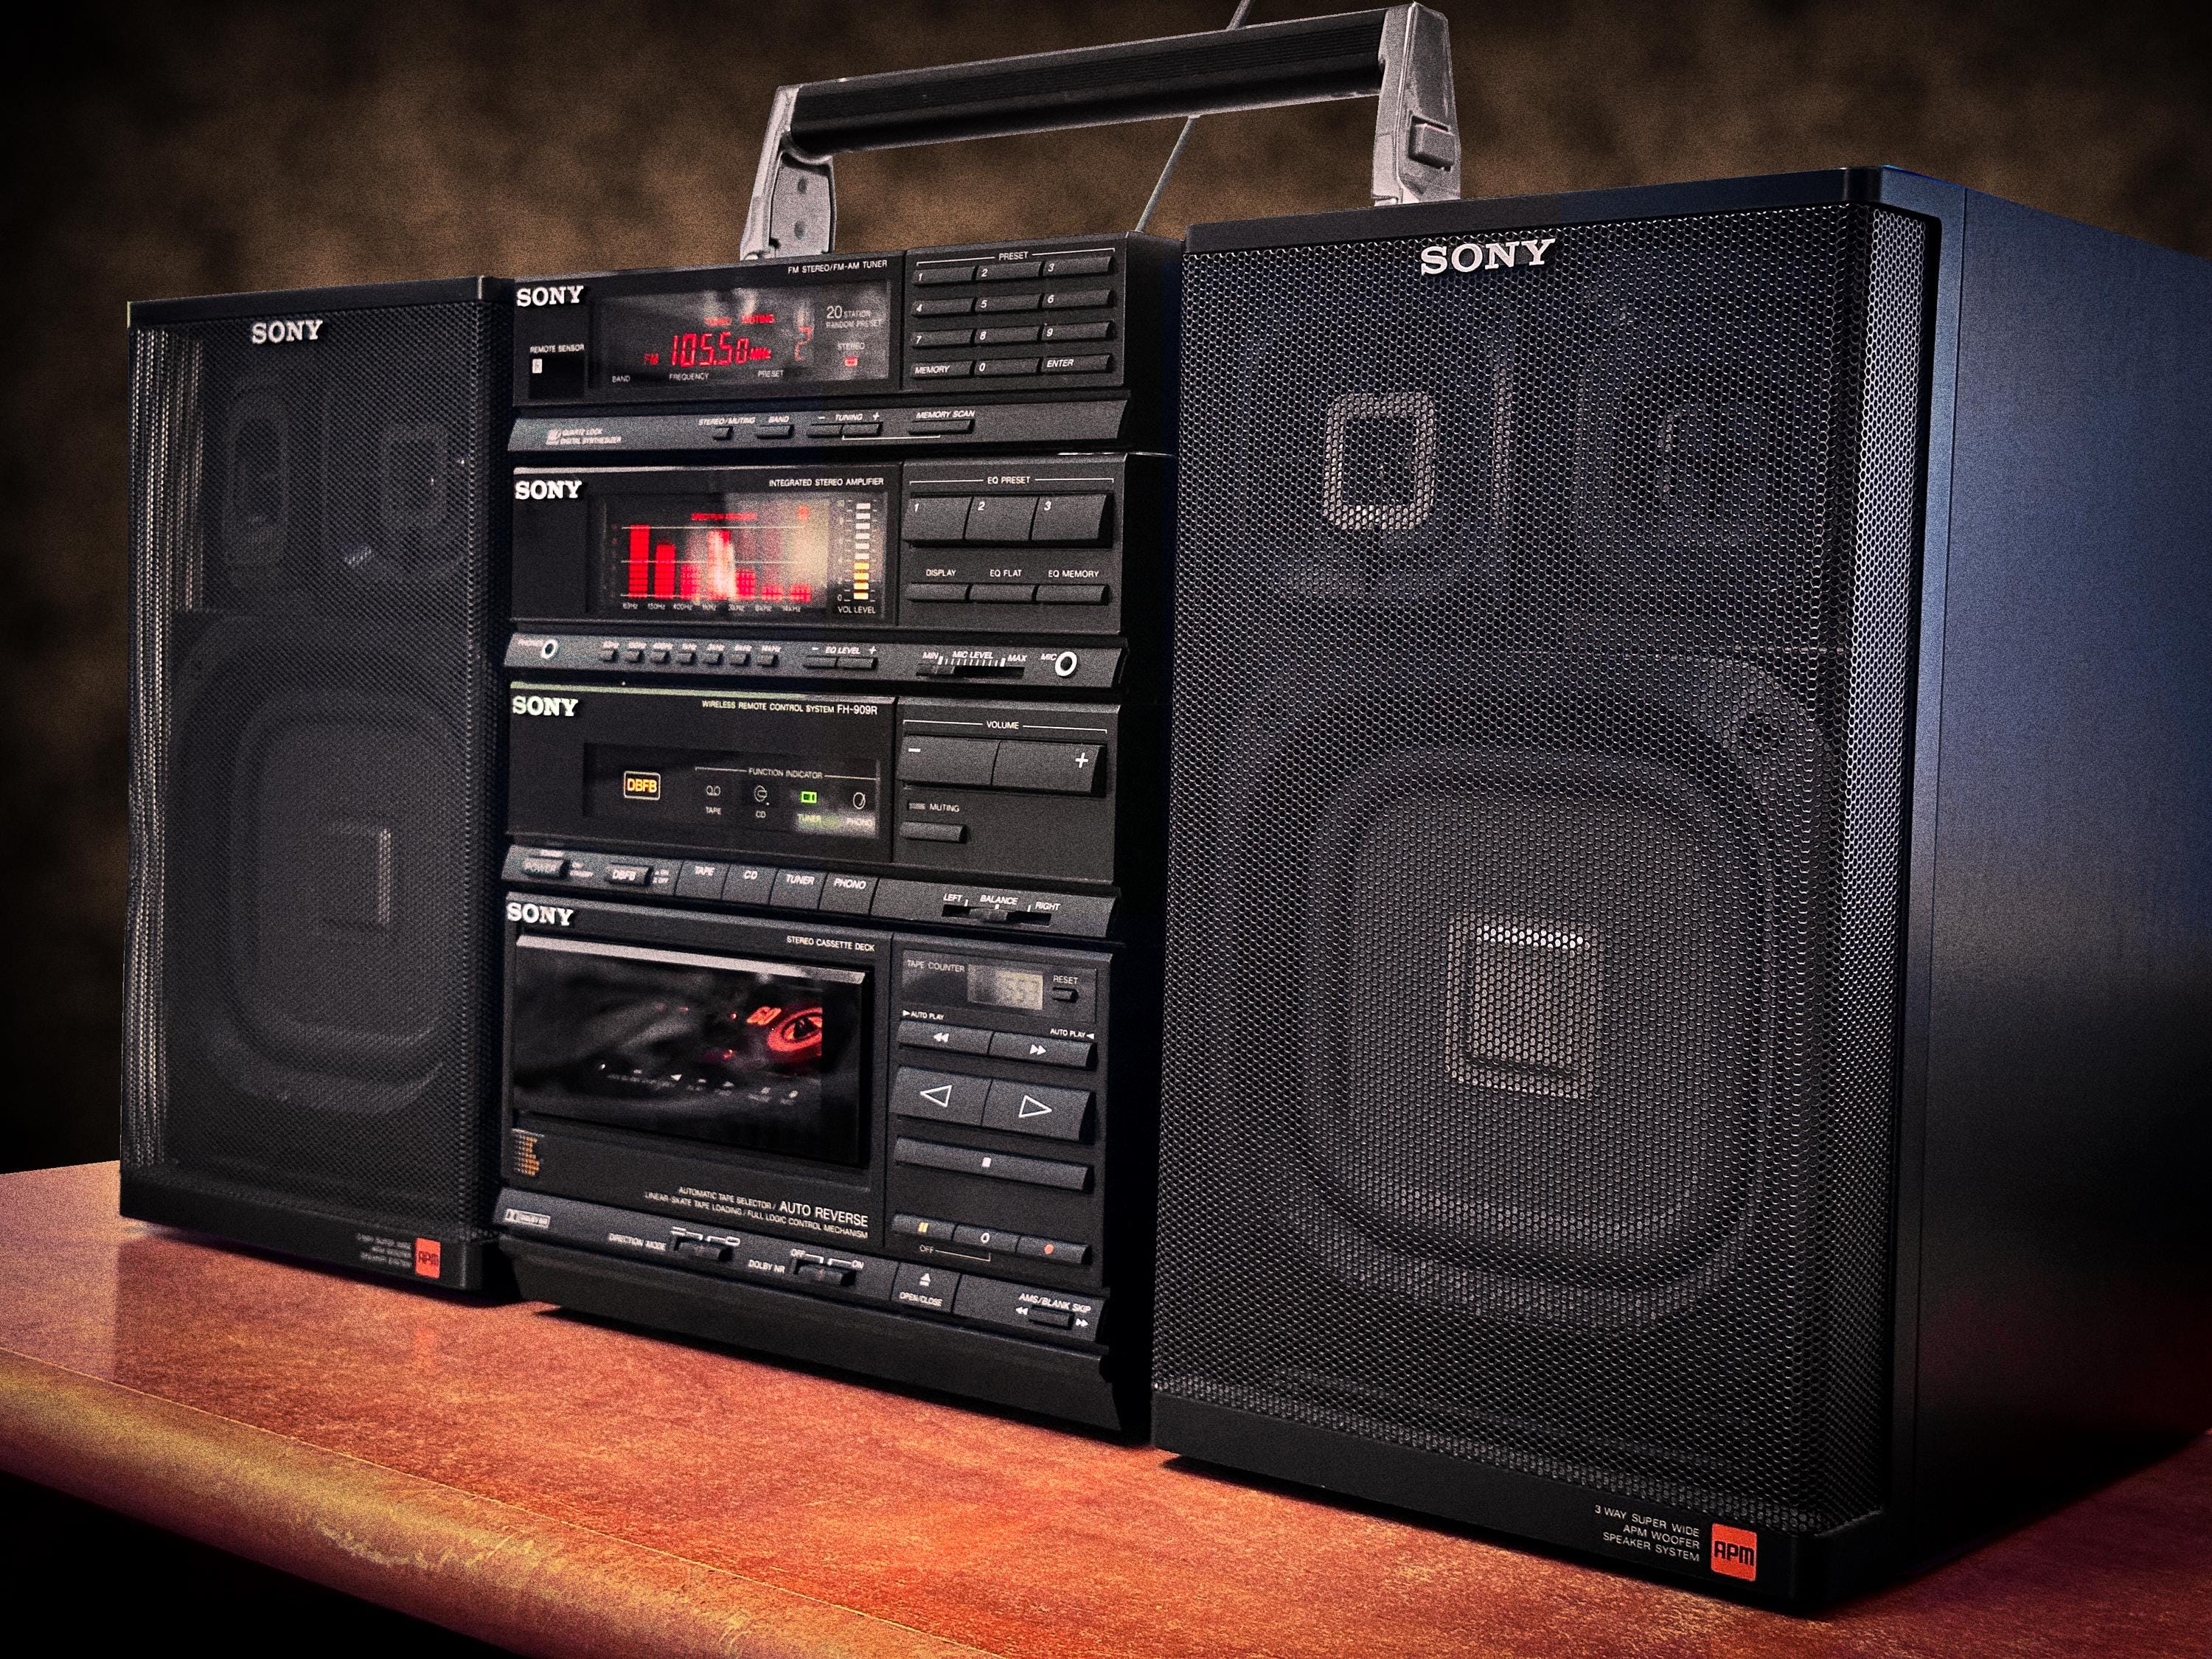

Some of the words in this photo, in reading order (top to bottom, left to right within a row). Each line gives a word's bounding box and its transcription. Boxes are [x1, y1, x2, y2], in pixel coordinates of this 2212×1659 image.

[999, 251, 1029, 260] PRESET
[1421, 238, 1556, 276] SONY
[787, 266, 799, 274] FM
[801, 262, 860, 274] STEREO/FM-AM
[863, 260, 888, 268] TUNER
[1048, 264, 1054, 272] 3
[918, 273, 923, 282] 1
[981, 268, 988, 277] 2
[517, 285, 584, 307] SONY
[1047, 295, 1054, 303] 6
[916, 304, 922, 312] 4
[981, 300, 987, 308] 5
[827, 305, 842, 319] 20
[844, 310, 872, 319] STATION
[251, 319, 323, 344] SONY
[979, 332, 987, 340] 8
[1046, 328, 1053, 337] 9
[916, 335, 922, 344] 7
[529, 345, 556, 353] REMOTE
[558, 344, 585, 352] SENSOR
[644, 353, 660, 365] FM
[671, 331, 750, 368] 105.50
[837, 342, 866, 351] STEREO
[979, 363, 986, 372] 0
[1046, 359, 1074, 368] ENTER
[757, 369, 784, 378] PRESET
[914, 366, 950, 375] MEMORY
[669, 372, 709, 381] FREQUENCY
[835, 413, 863, 422] TUNING
[916, 411, 951, 420] MEMORY
[953, 410, 975, 418] SCAN
[769, 479, 813, 487] INTEGRATED
[815, 478, 844, 487] STEREO
[846, 478, 884, 487] AMPLIFIER
[987, 476, 998, 484] EQ
[1001, 476, 1030, 484] PRESET
[515, 479, 582, 500] SONY
[914, 503, 919, 512] 1
[978, 501, 985, 511] 2
[1043, 501, 1051, 511] 3
[926, 568, 956, 577] DISPLAY
[990, 569, 1001, 577] EQ
[1004, 569, 1022, 577] FLAT
[1048, 569, 1060, 578] EQ
[1062, 570, 1099, 578] MEMORY
[838, 606, 852, 614] VOL
[854, 606, 876, 614] LEVEL
[825, 646, 837, 654] EQ
[838, 647, 860, 655] LEVEL
[922, 651, 939, 660] MIN
[952, 650, 968, 658] MIC
[970, 651, 994, 660] LEVEL
[1008, 653, 1027, 662] MAX
[1040, 653, 1057, 661] MIC
[512, 695, 579, 717] SONY
[702, 700, 736, 709] WIRELESS
[738, 702, 767, 711] REMOTE
[769, 703, 804, 712] CONTROL
[806, 705, 835, 713] SYSTEM
[837, 704, 877, 715] FH-909R
[987, 720, 1019, 729] VOLUME
[749, 768, 784, 777] FUNCTION
[786, 770, 823, 779] INDICATOR
[627, 777, 658, 793] DBFB
[706, 807, 722, 815] TAPE
[930, 803, 960, 813] MUTING
[756, 810, 766, 818] CD
[797, 813, 822, 824] TUNER
[612, 869, 636, 880] DBFB
[695, 866, 715, 876] TAPE
[743, 870, 758, 880] CD
[786, 874, 815, 886] TUNER
[834, 877, 866, 889] PHONO
[943, 893, 961, 902] LEFT
[980, 895, 1018, 905] BALANCE
[1035, 902, 1060, 911] RIGHT
[507, 902, 574, 927] SONY
[787, 935, 814, 945] STEREO
[816, 938, 853, 950] CASSETTE
[855, 942, 875, 952] DECK
[907, 959, 925, 969] TAPE
[928, 961, 965, 973] COUNTER
[1053, 975, 1078, 984] RESET
[911, 1010, 928, 1019] AUTO
[929, 1012, 945, 1020] PLAY
[1050, 1028, 1068, 1036] AUTO
[1070, 1029, 1086, 1039] PLAY
[678, 1186, 717, 1200] AUTOMATIC
[718, 1193, 735, 1203] TAPE
[737, 1196, 771, 1209] SELECTOR
[779, 1200, 811, 1217] AUTO
[815, 1206, 869, 1228] REVERSE
[644, 1191, 669, 1202] LINEAR
[671, 1195, 692, 1206] SKATE
[694, 1199, 710, 1210] TAPE
[712, 1203, 742, 1216] LOADING
[748, 1209, 763, 1220] FULL
[765, 1212, 787, 1224] LOGIC
[788, 1217, 822, 1231] CONTROL
[824, 1223, 869, 1239] MECHANISM
[919, 1245, 933, 1253] OFF
[418, 1251, 439, 1266] APM
[748, 1259, 772, 1270] DOLBY
[899, 1291, 943, 1308] OPEN/CLOSE
[1018, 1293, 1070, 1310] AMS/BLANK
[1072, 1303, 1091, 1313] SKIP
[1594, 1504, 1601, 1514] 3
[1604, 1507, 1627, 1520] WAY
[1631, 1513, 1667, 1530] SUPER
[1672, 1523, 1700, 1537] WIDE
[1623, 1524, 1648, 1537] APM
[1651, 1530, 1700, 1549] WOOFER
[1603, 1531, 1651, 1551] SPEAKER
[1655, 1544, 1700, 1562] SYSTEM
[1714, 1540, 1755, 1566] APM
